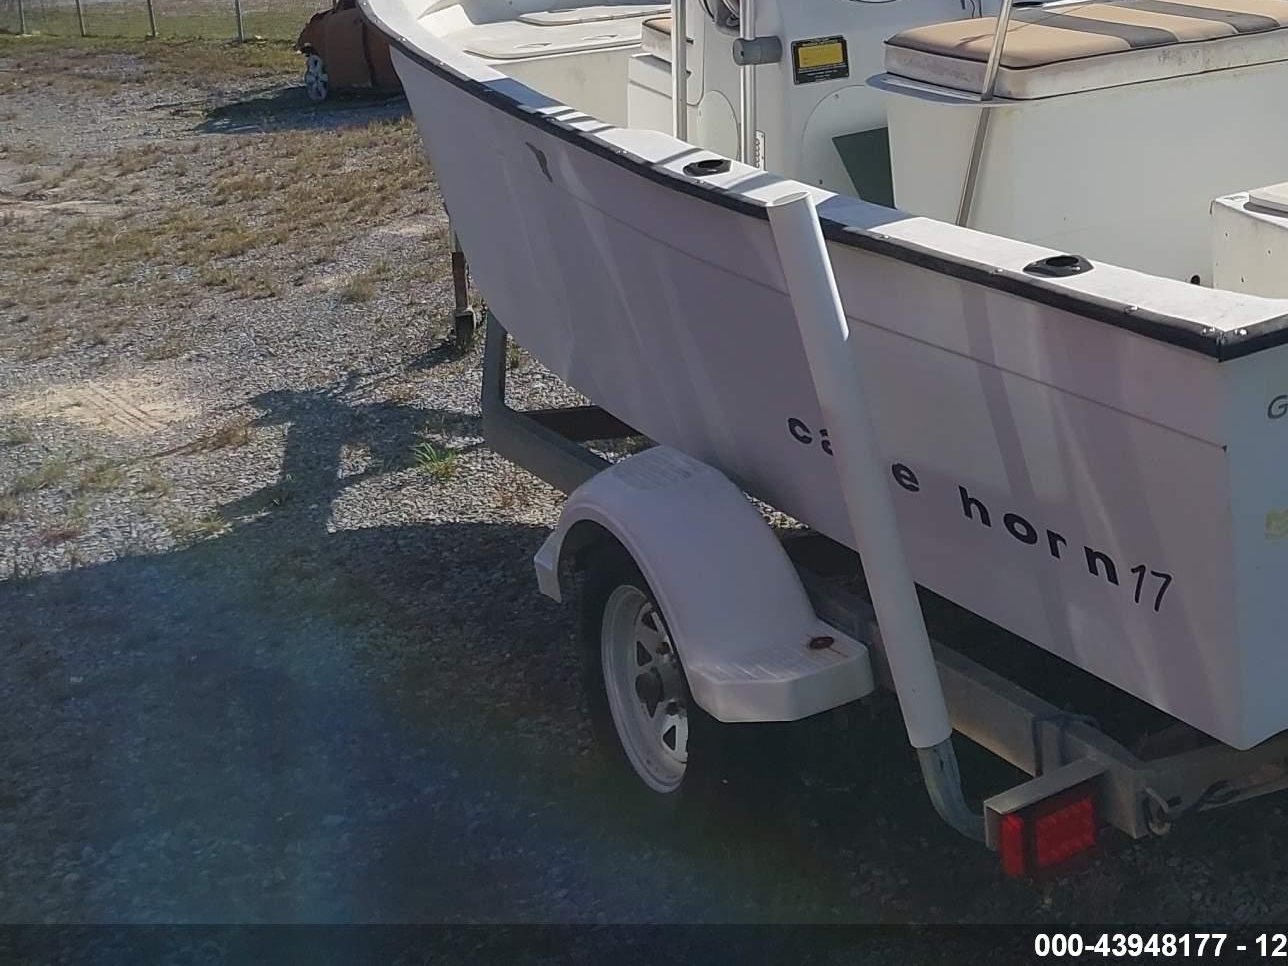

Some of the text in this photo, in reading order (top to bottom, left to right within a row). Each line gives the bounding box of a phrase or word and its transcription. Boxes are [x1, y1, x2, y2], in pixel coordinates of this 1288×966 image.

[788, 417, 1173, 613] ce horn 17
